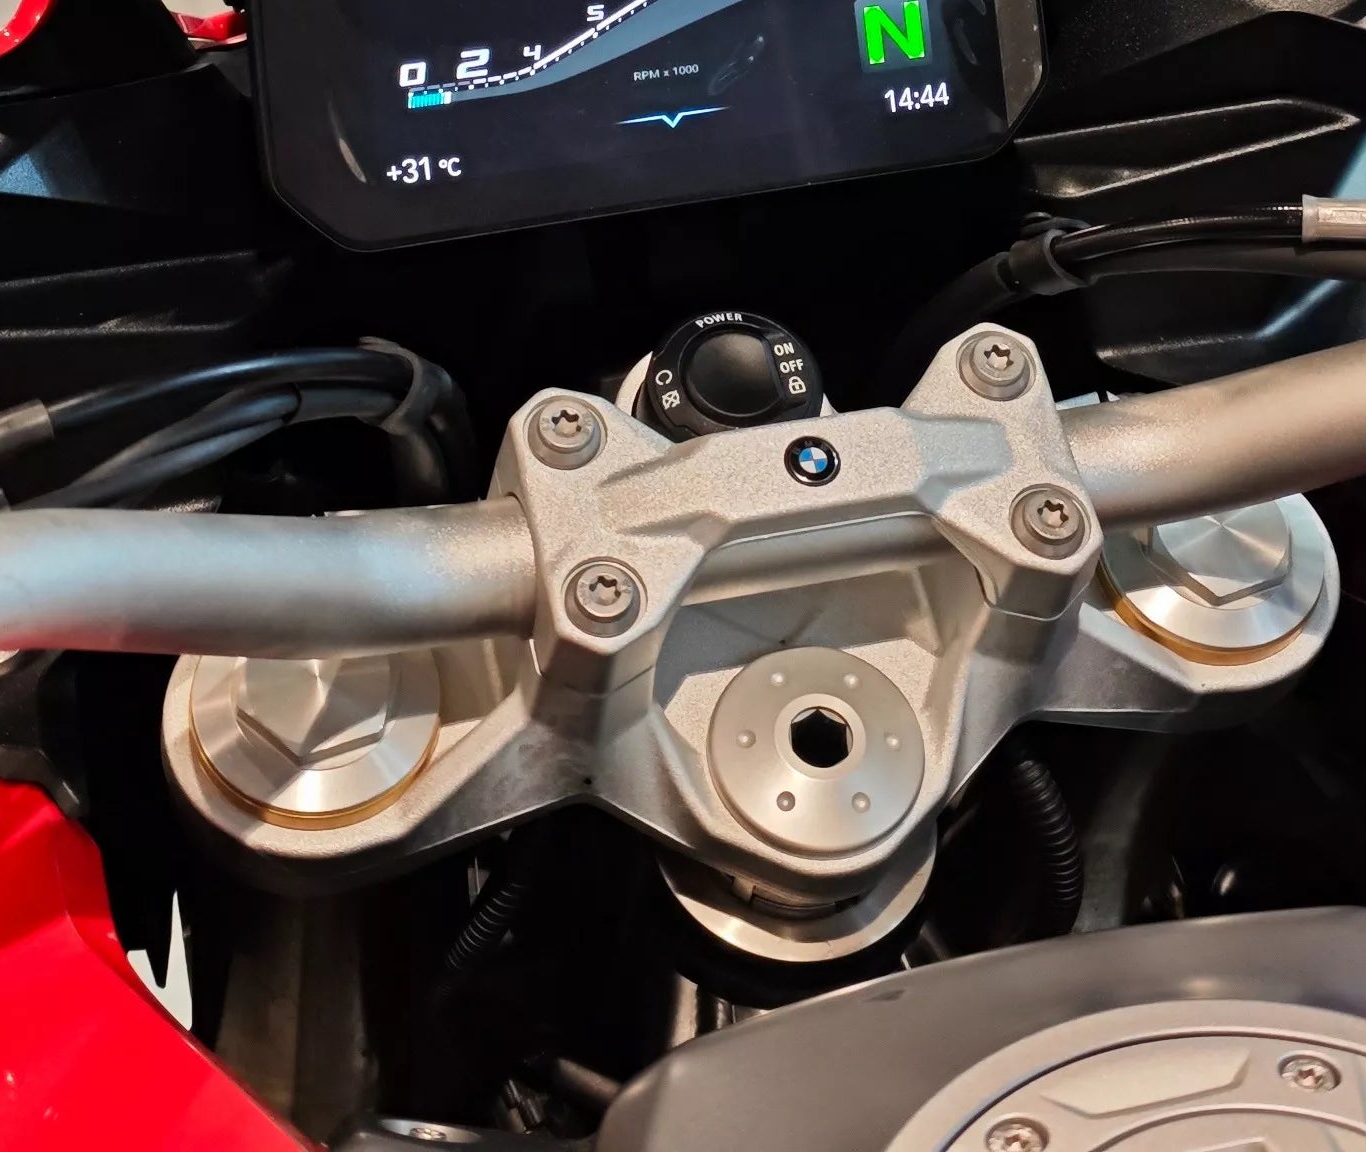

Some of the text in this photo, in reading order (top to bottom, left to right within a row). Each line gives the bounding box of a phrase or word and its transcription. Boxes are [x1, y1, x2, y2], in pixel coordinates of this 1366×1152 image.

[863, 0, 925, 64] N
[399, 61, 426, 87] 0
[456, 49, 489, 79] 2
[523, 45, 542, 60] 4
[586, 4, 604, 21] 5
[633, 69, 660, 81] RPM
[672, 64, 699, 75] 1000
[884, 82, 949, 113] 14:44
[387, 156, 431, 184] +31
[695, 312, 743, 328] POWER
[774, 342, 795, 356] ON
[779, 359, 804, 373] OFF
